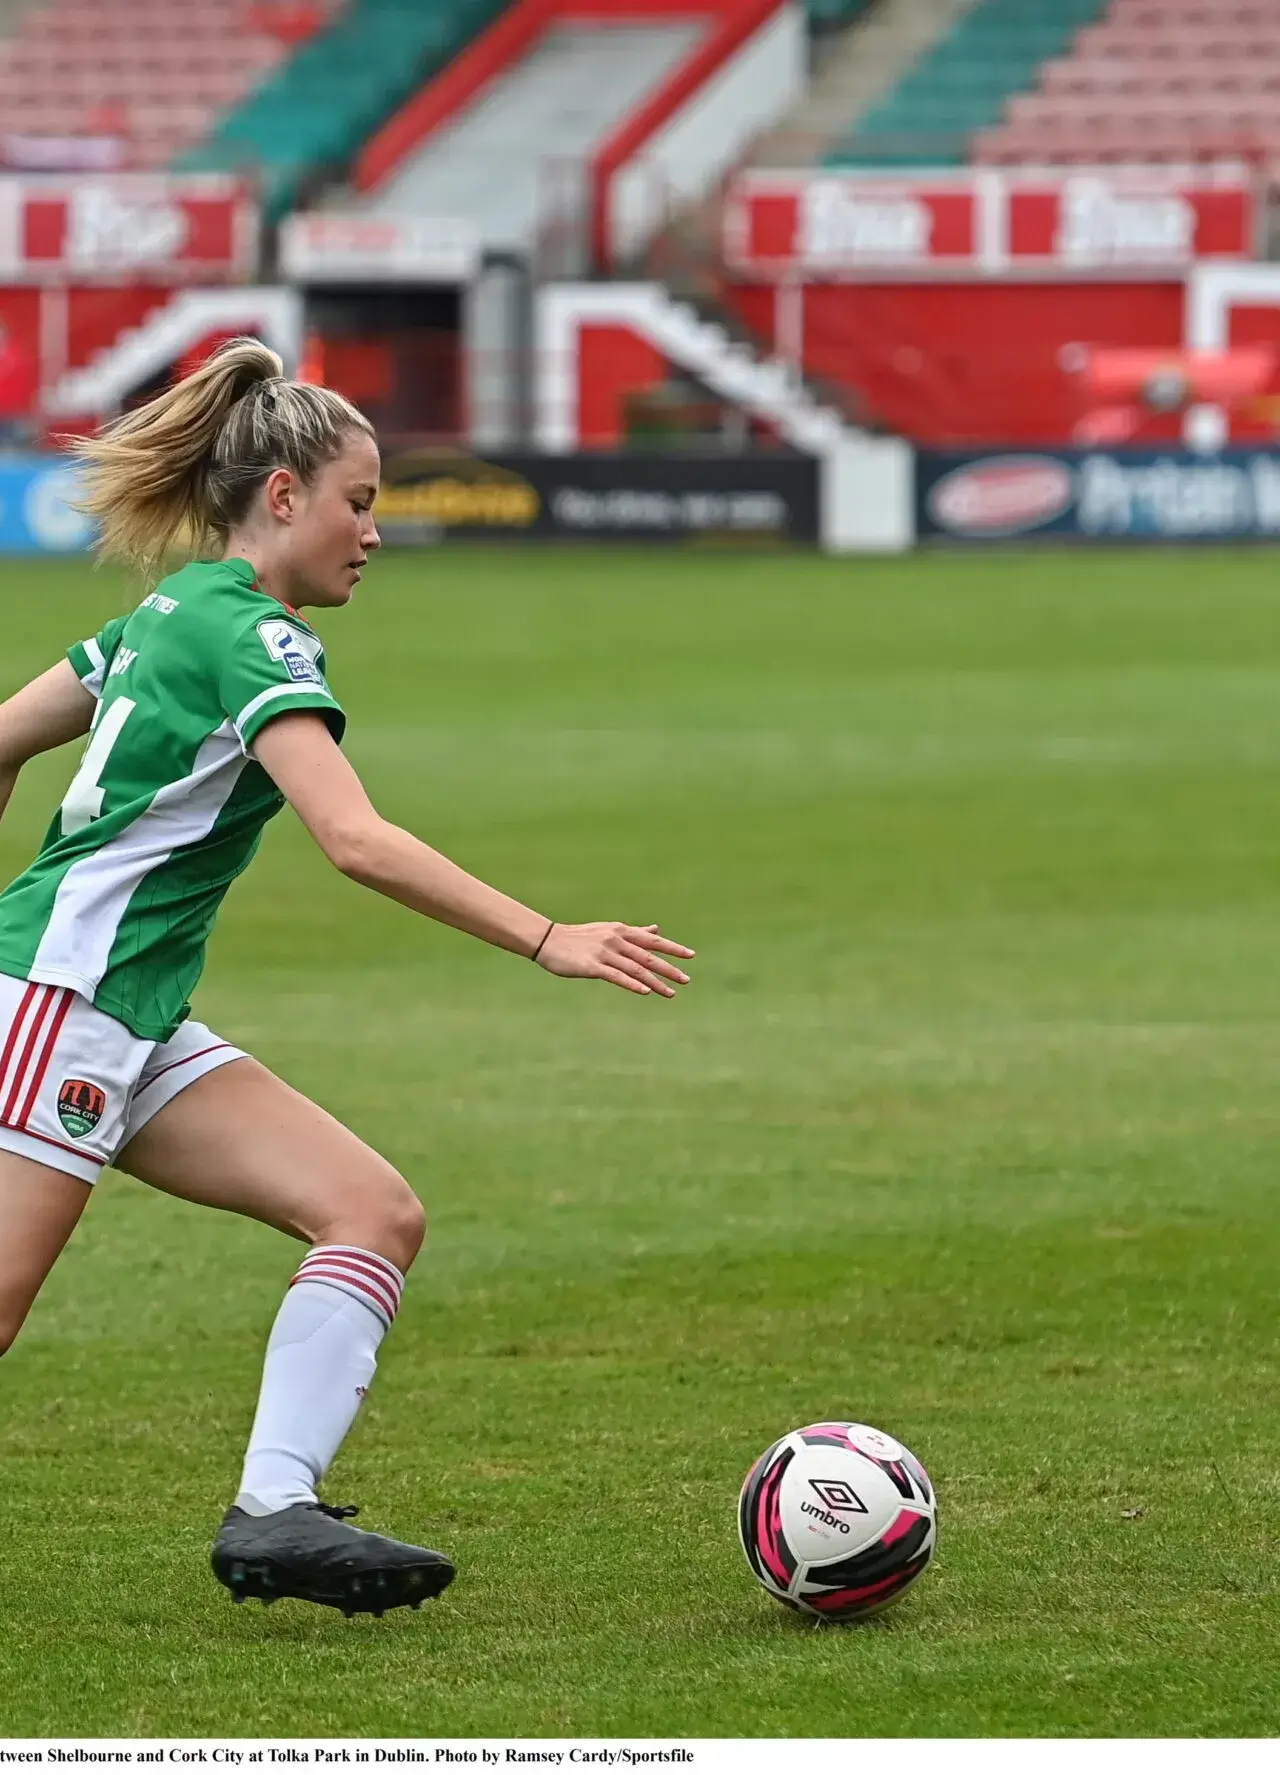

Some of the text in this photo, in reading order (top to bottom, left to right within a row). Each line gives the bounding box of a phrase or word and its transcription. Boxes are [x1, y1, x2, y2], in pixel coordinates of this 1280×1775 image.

[59, 1102, 82, 1116] CORK
[82, 1109, 100, 1122] CITY
[800, 1501, 851, 1535] umbro
